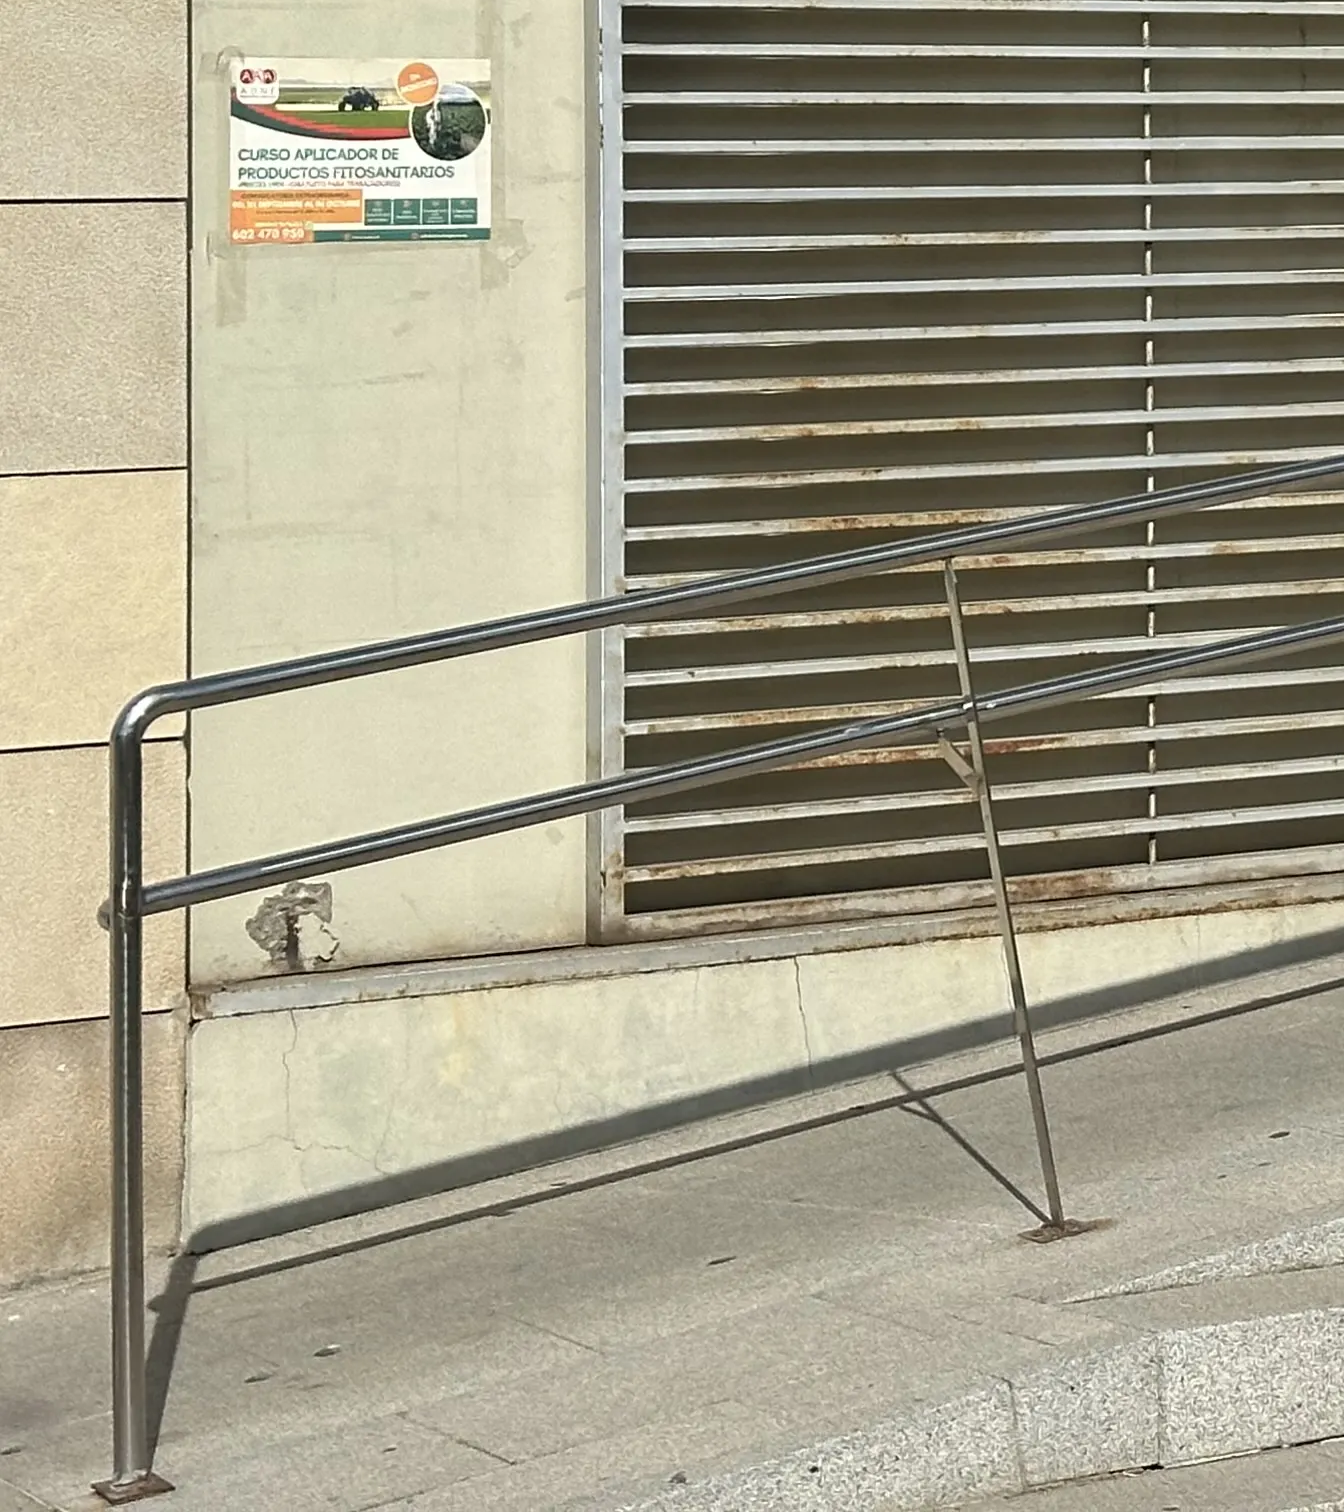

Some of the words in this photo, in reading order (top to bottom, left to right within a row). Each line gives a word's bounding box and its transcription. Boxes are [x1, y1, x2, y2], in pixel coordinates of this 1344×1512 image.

[238, 148, 291, 161] CURSO
[294, 148, 378, 161] APLICADOR
[382, 148, 400, 161] DE
[238, 166, 330, 180] PRODUCTOS
[333, 165, 455, 179] FITOSANITARIOS
